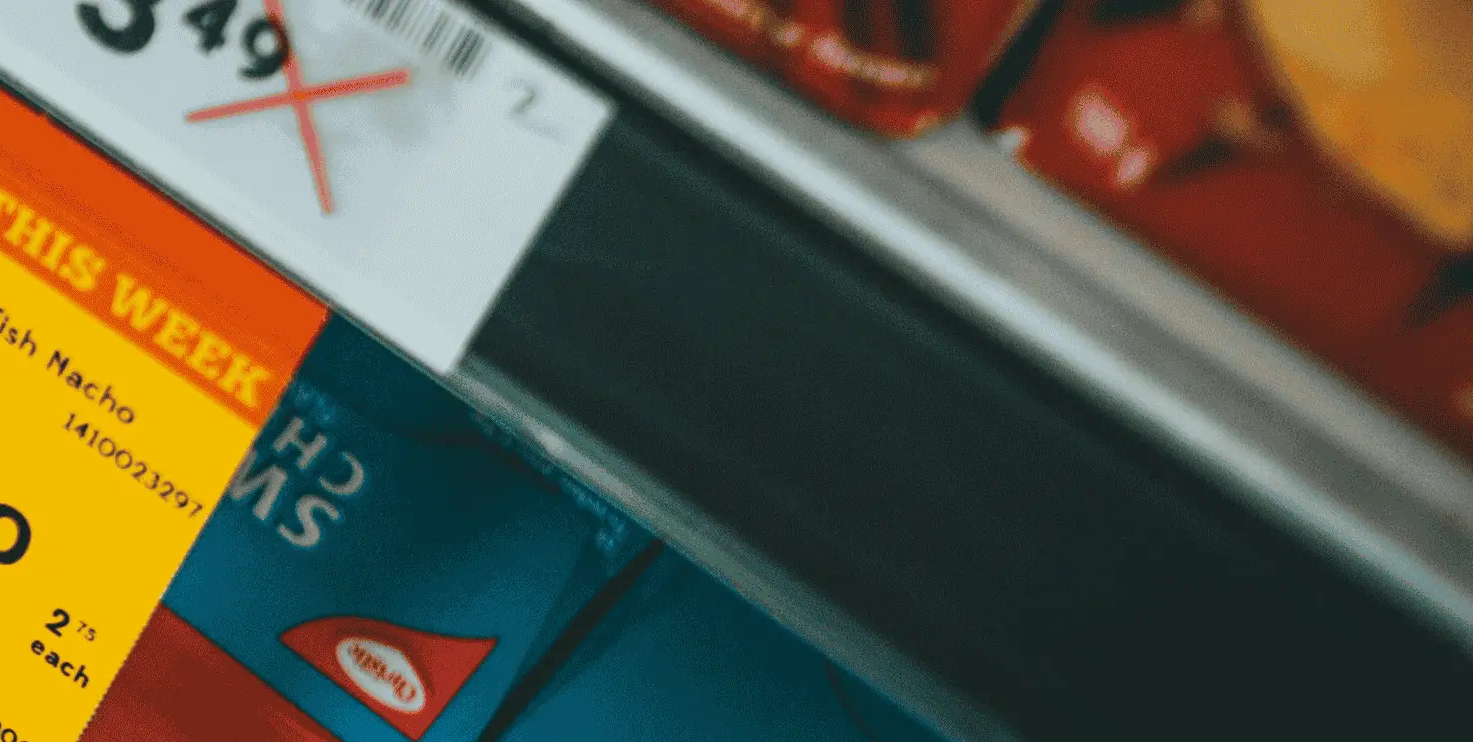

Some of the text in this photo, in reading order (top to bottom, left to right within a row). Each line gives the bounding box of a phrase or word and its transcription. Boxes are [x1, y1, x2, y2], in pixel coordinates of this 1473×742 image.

[110, 272, 271, 407] WEEK
[46, 350, 135, 425] Nacho
[61, 412, 205, 519] 1410023297
[45, 608, 71, 637] 2
[30, 639, 90, 689] each
